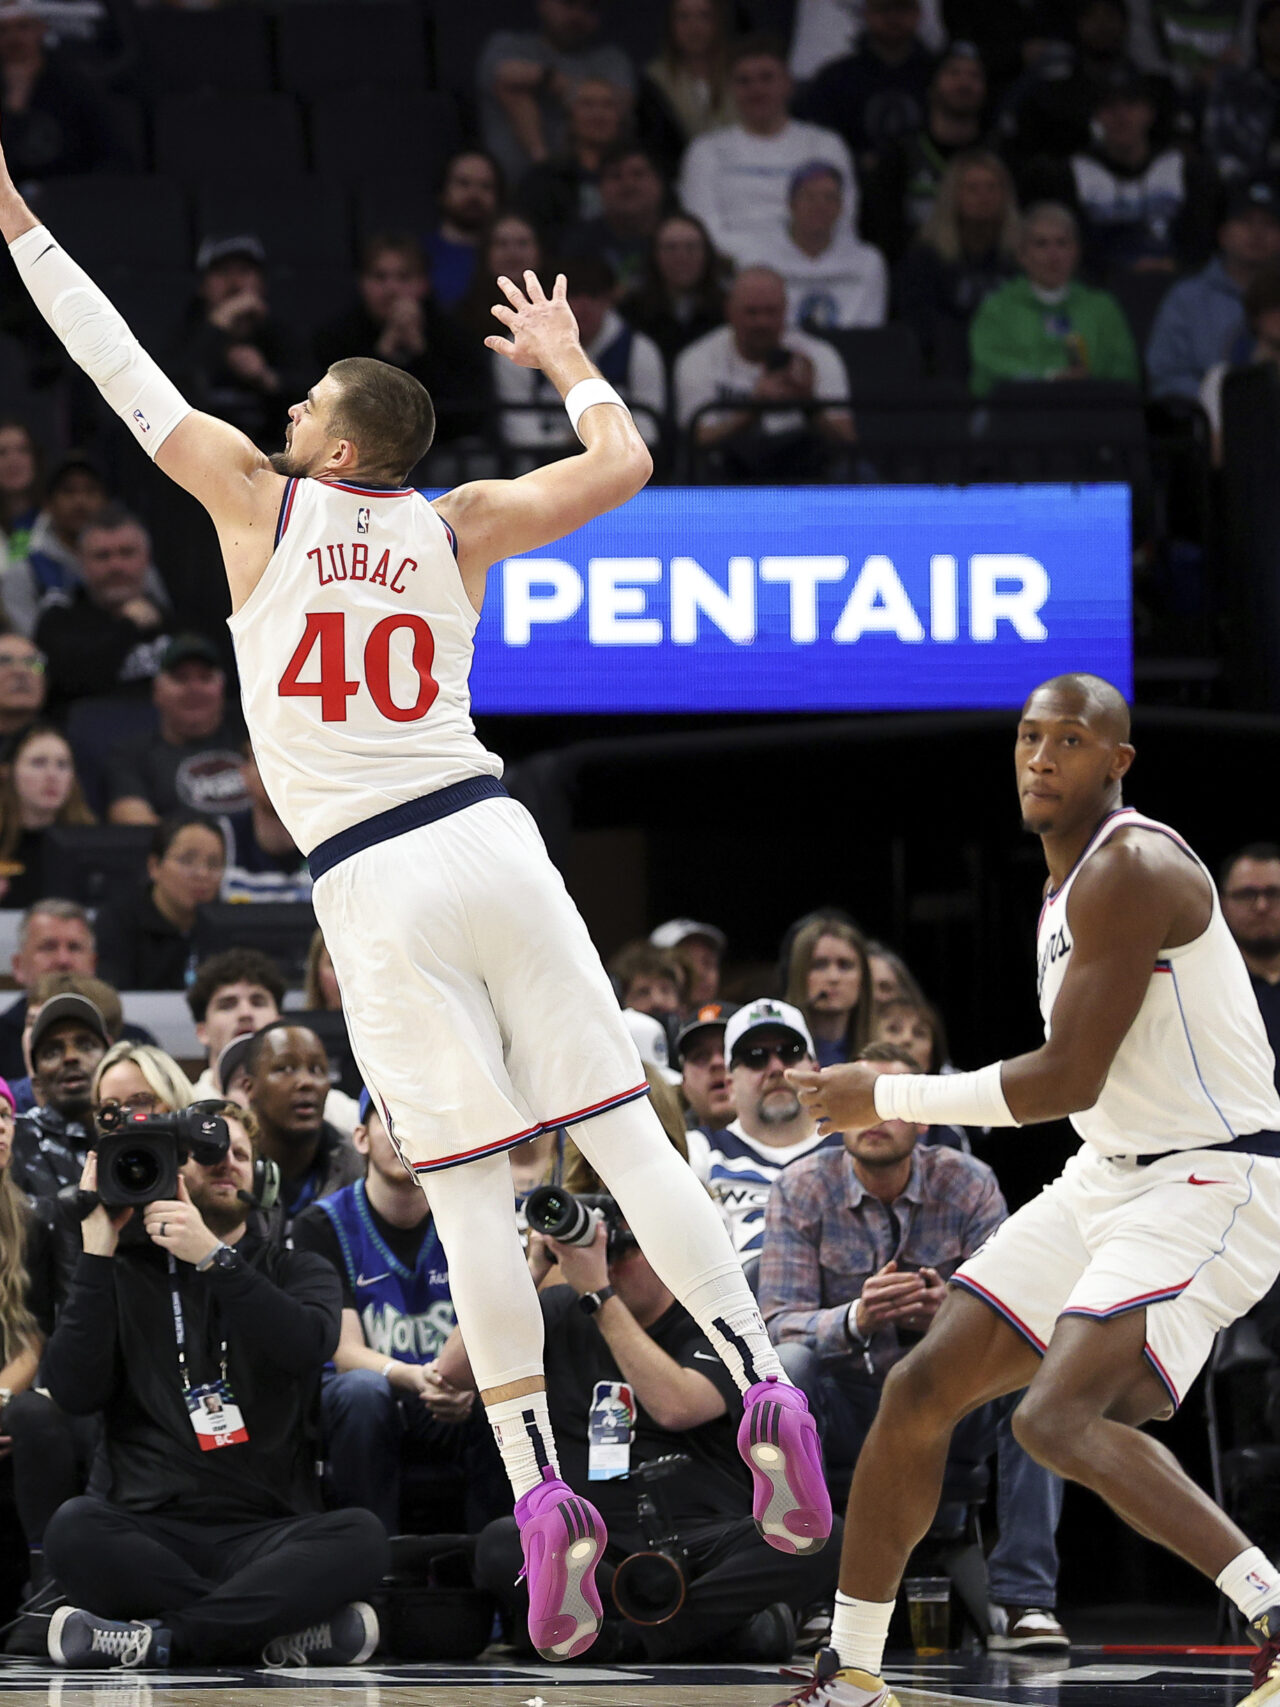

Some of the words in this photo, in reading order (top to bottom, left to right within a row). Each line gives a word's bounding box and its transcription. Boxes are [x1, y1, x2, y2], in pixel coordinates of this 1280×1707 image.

[306, 543, 418, 594] ZUBAC
[502, 552, 1051, 647] PENTAIR
[277, 612, 440, 722] 40
[215, 1432, 234, 1446] BC
